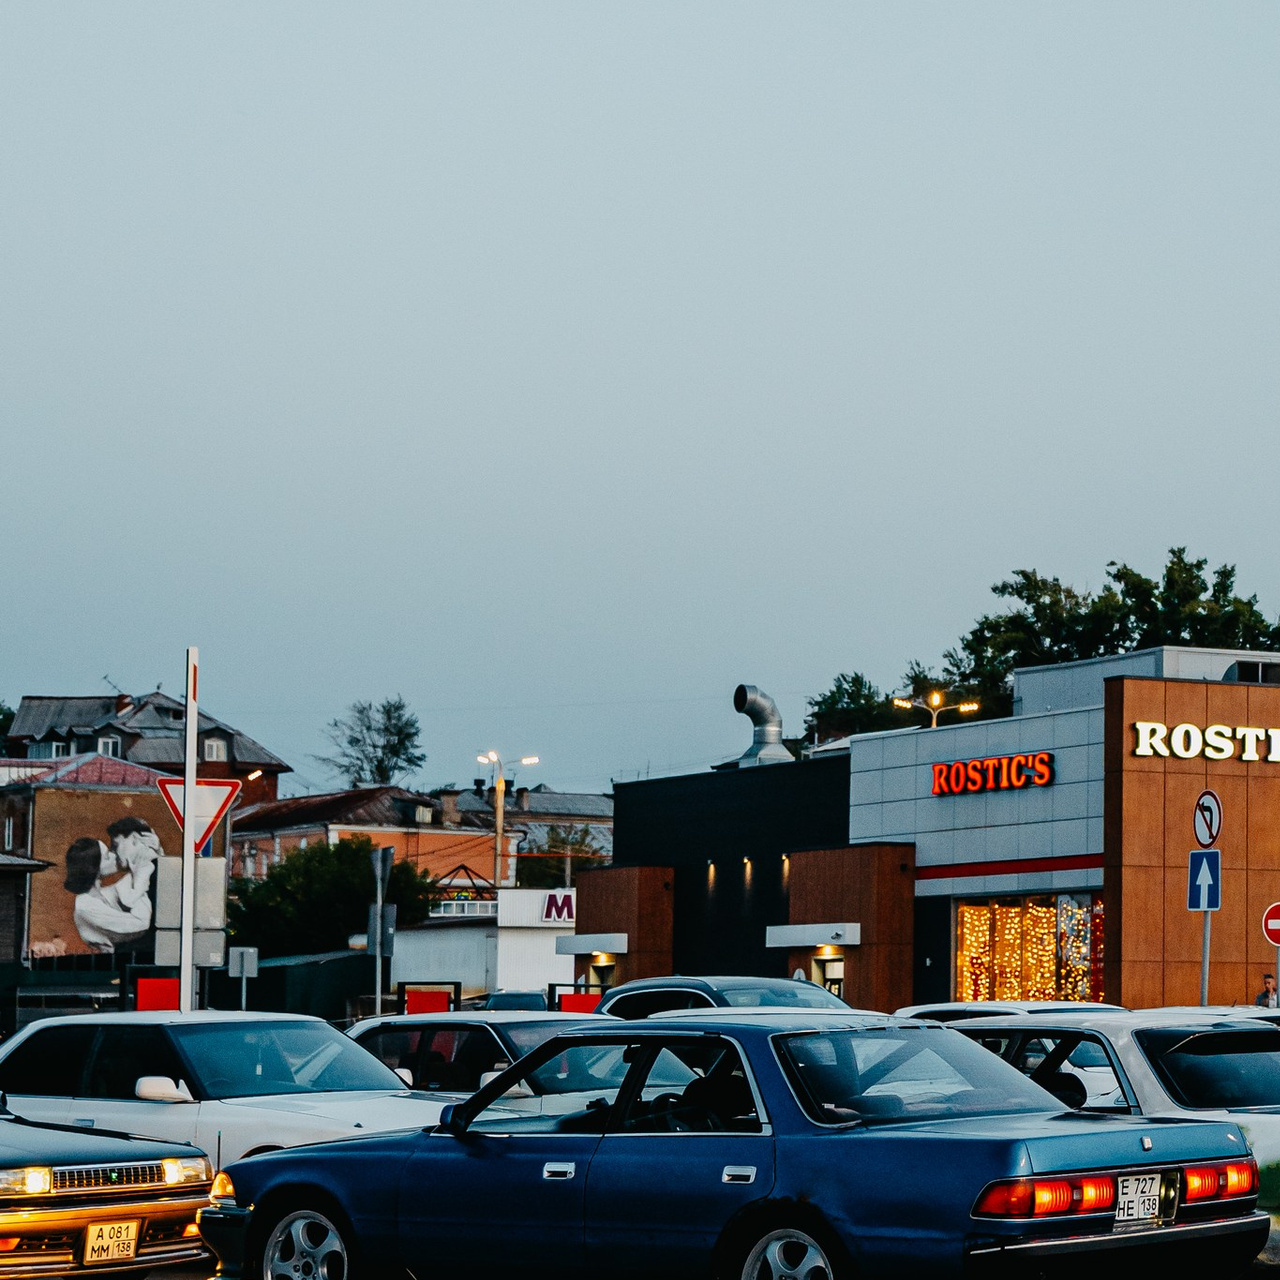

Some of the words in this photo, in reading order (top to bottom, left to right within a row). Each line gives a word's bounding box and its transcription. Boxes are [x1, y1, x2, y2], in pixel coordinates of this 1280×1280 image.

[931, 751, 1053, 796] ROSTIC'S
[1134, 1177, 1156, 1195] 727
[1140, 1198, 1157, 1212] 138
[109, 1225, 129, 1240] 081
[115, 1241, 131, 1253] 138
